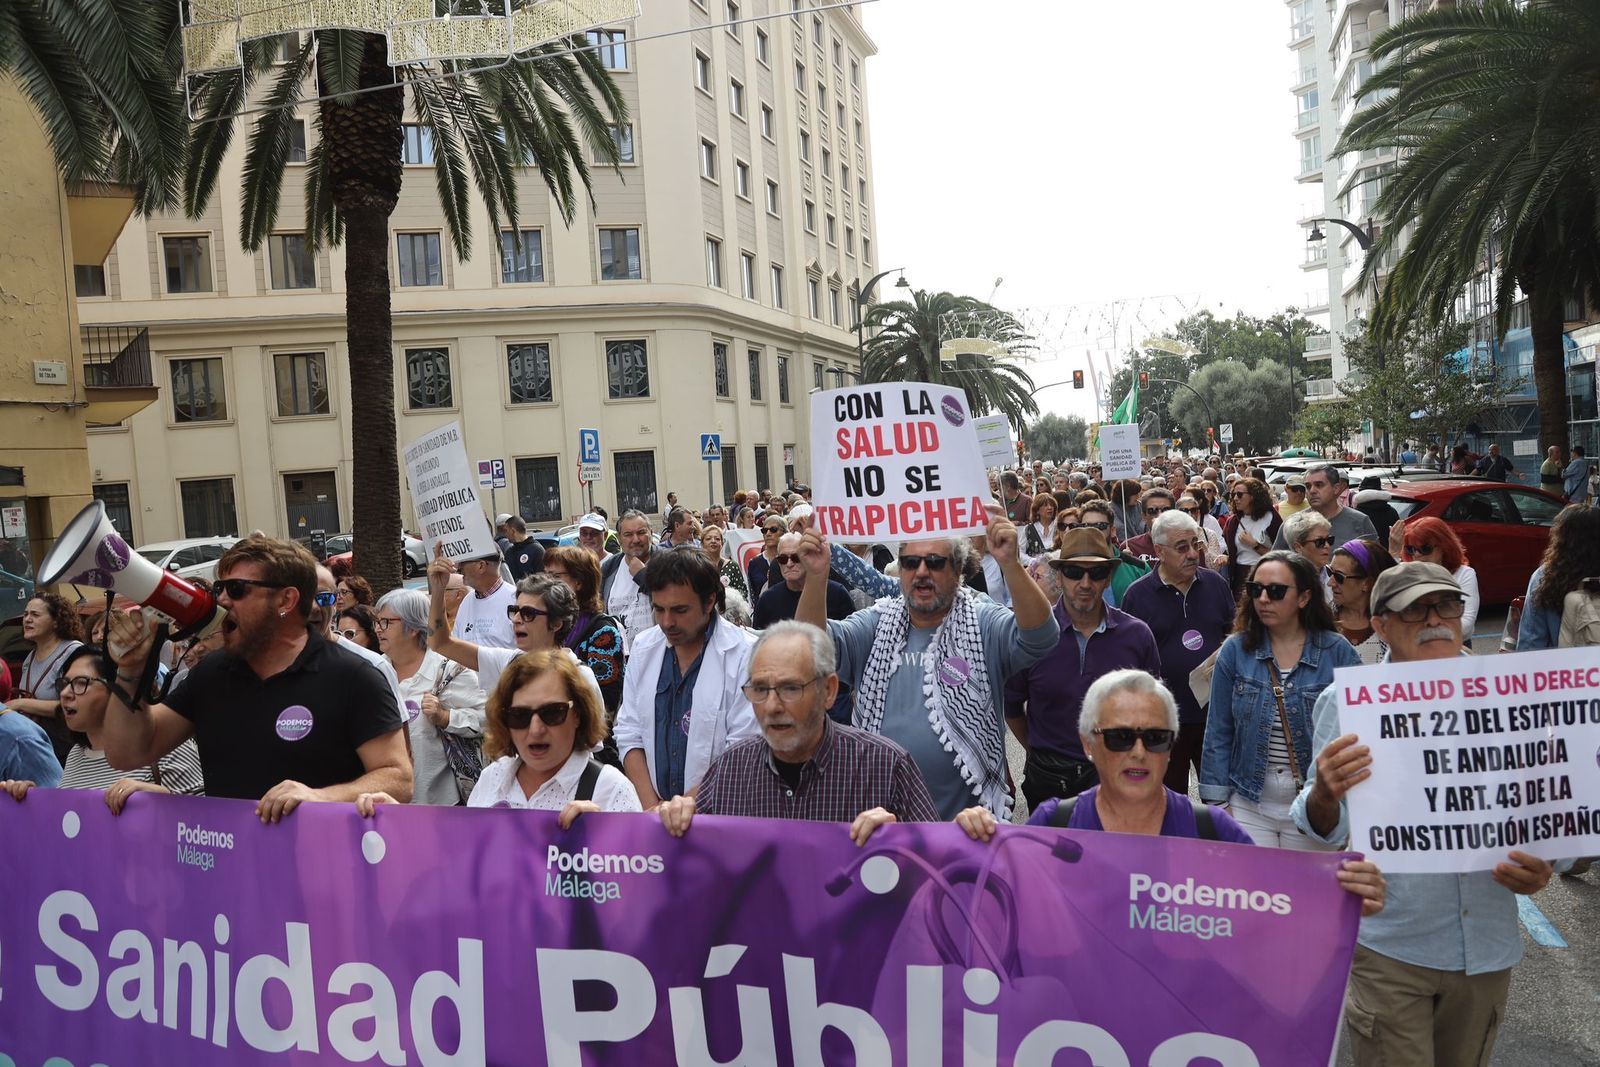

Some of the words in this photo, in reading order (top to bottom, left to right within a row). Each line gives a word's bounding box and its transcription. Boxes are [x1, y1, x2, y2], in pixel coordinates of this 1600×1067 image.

[835, 391, 883, 422] CON
[902, 390, 935, 415] LA
[837, 421, 939, 460] SALUD
[493, 461, 502, 474] P
[844, 465, 885, 497] NO
[905, 465, 941, 493] SE
[438, 487, 476, 513] PÚBLICA
[816, 496, 989, 536] TRAPICHEA
[436, 515, 465, 536] VENDE
[1345, 686, 1373, 705] LA
[1378, 680, 1455, 703] SALUD
[1462, 677, 1488, 697] ES
[1495, 674, 1528, 696] UN
[1380, 712, 1426, 739] ART.
[1430, 711, 1459, 737] 22
[1465, 708, 1504, 735] DEL
[1509, 699, 1600, 731] ESTATUTO
[1423, 749, 1453, 775] DE
[1458, 735, 1568, 774] ANDALUCÍA
[1424, 787, 1438, 812] Y
[1445, 785, 1491, 812] ART.
[1496, 782, 1521, 809] 43
[1526, 778, 1546, 805] DE
[1550, 775, 1573, 801] LA
[178, 822, 234, 849] Podemos
[1369, 816, 1529, 852] CONSTITUCIÓN
[177, 844, 214, 871] Málaga
[546, 845, 665, 874] Podemos
[545, 872, 621, 904] Málaga
[1129, 873, 1292, 915] Podemos
[1129, 903, 1232, 940] Málaga
[34, 889, 487, 1067] Sanidad
